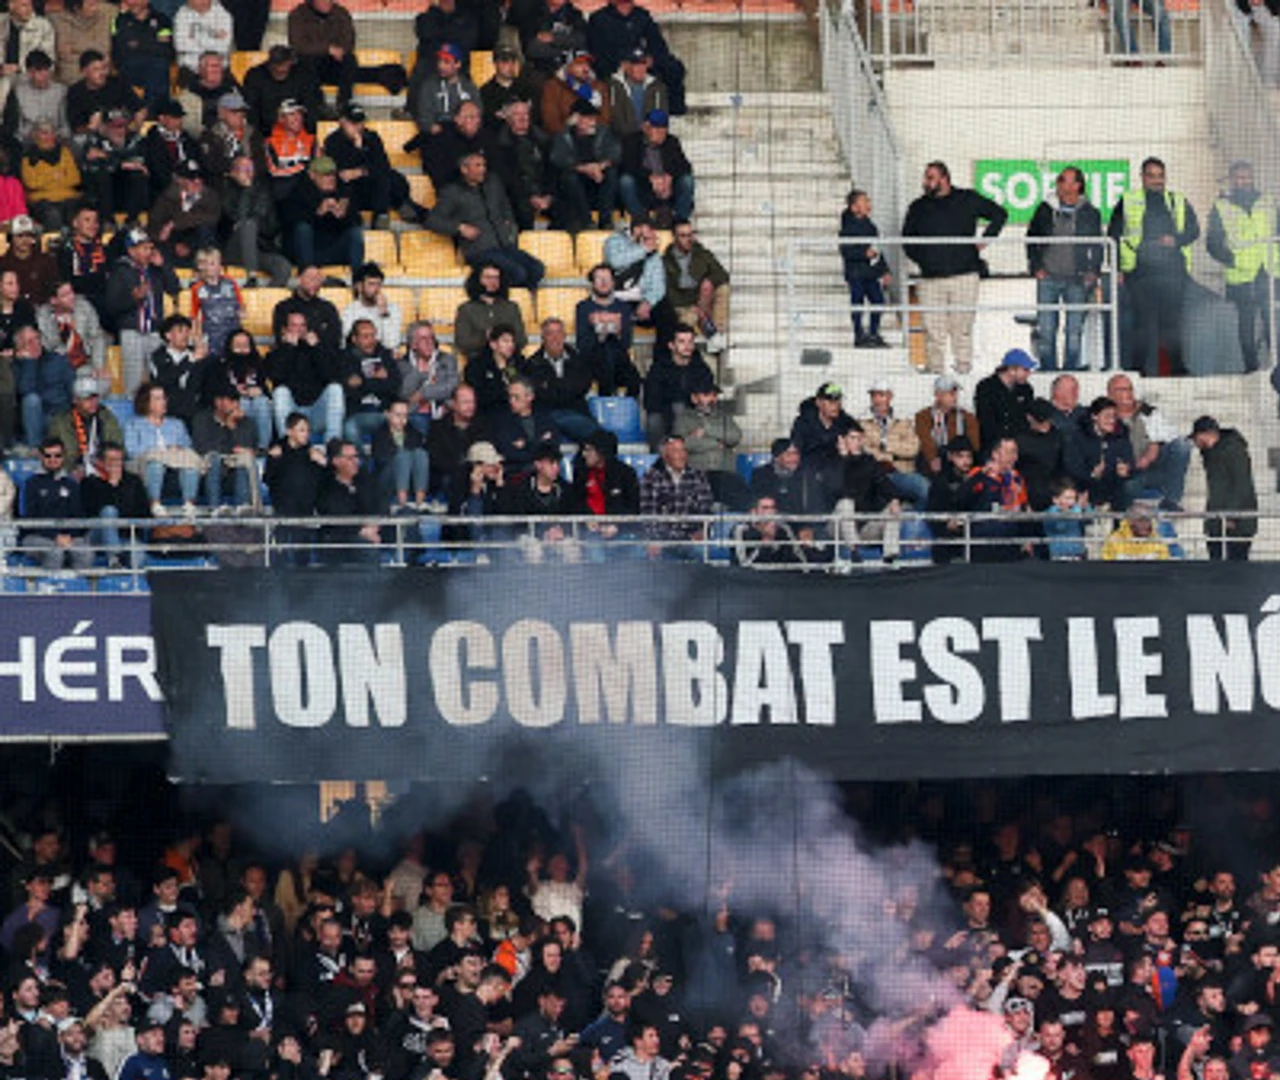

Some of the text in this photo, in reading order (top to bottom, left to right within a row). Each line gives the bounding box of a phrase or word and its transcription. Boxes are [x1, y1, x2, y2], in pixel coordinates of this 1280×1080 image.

[207, 622, 407, 728] TON
[429, 620, 844, 727] COMBAT
[870, 619, 1042, 723] EST
[1068, 616, 1168, 719] LE
